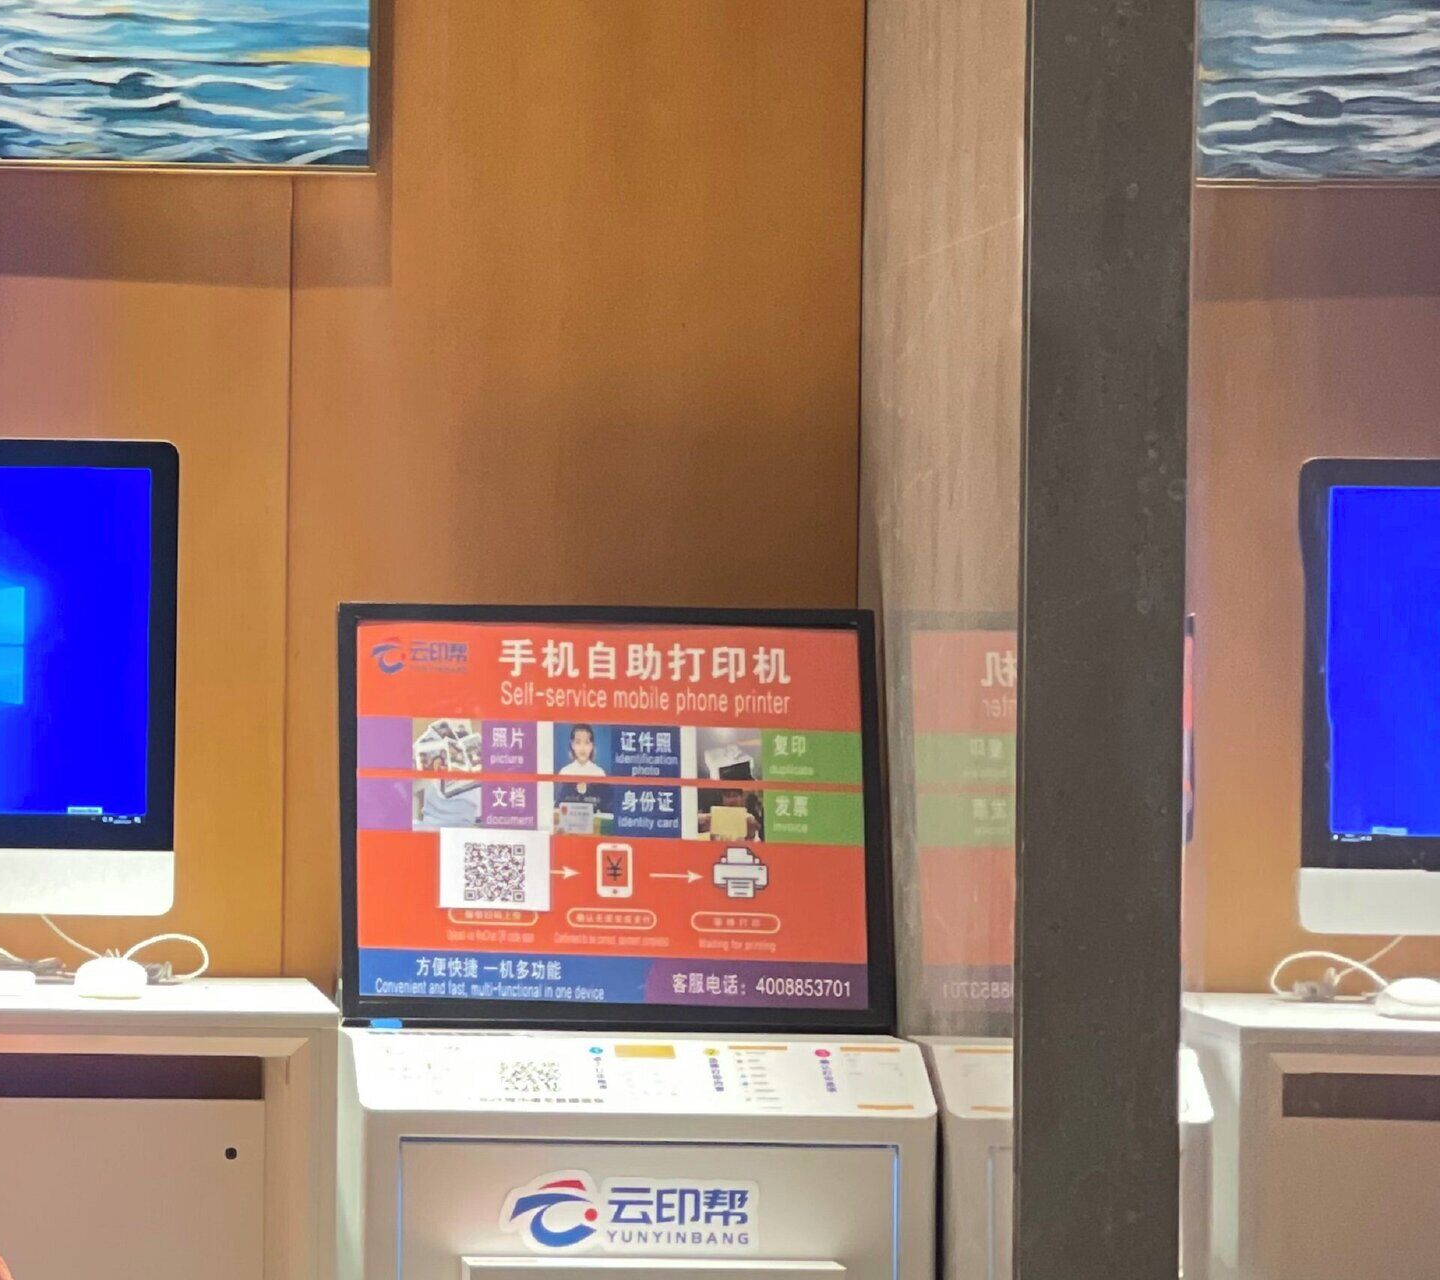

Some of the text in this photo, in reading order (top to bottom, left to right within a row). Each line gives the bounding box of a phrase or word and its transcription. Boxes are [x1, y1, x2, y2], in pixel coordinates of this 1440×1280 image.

[498, 639, 791, 684] 手机自助打印机
[501, 681, 791, 717] Self-service mobile phone printer
[491, 727, 524, 749] 照片
[620, 731, 672, 753] 证件照
[774, 735, 806, 756] 复印
[490, 754, 524, 767] picture
[616, 752, 678, 765] identification
[631, 765, 660, 777] photo
[492, 787, 526, 808] 文档
[622, 790, 674, 813] 身份证
[775, 796, 809, 818] 发票
[486, 815, 534, 826] document
[617, 815, 679, 830] identity card
[416, 956, 562, 981] 方便快捷 一机多功能
[375, 977, 427, 995] Convenient
[428, 980, 446, 995] and
[471, 982, 542, 998] multi-functional
[544, 985, 553, 998] in
[555, 987, 573, 1000] one
[575, 986, 605, 1001] device
[755, 977, 851, 998] 4008853701
[607, 1186, 750, 1227] 云印帮
[607, 1229, 751, 1246] YUNYINBANG
